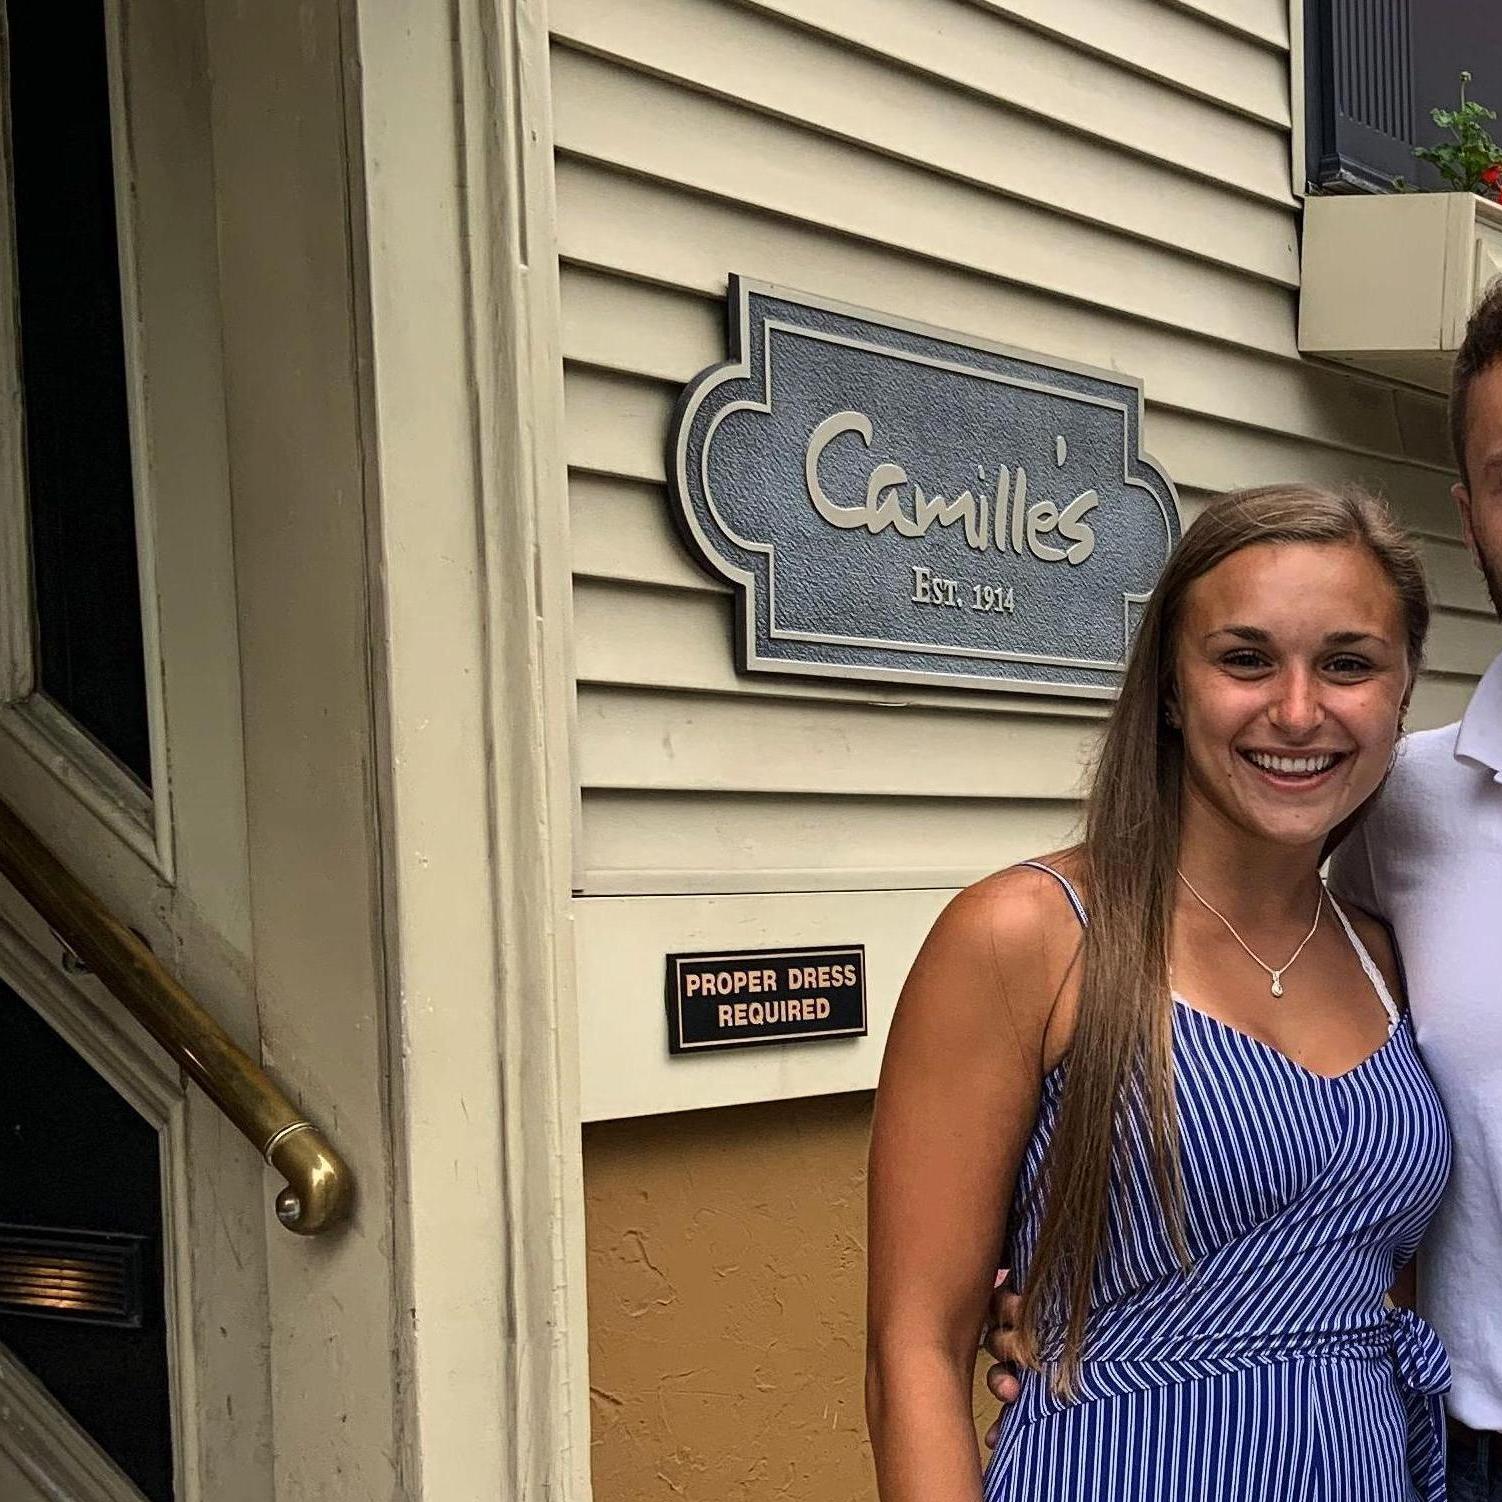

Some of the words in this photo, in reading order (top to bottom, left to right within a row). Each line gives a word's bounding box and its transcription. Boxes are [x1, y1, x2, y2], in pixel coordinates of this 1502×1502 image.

[805, 411, 1100, 565] Camille's
[973, 585, 1015, 614] 1914
[685, 969, 777, 998] PROPER
[788, 964, 857, 990] DRESS
[718, 997, 831, 1028] REQUIRED
